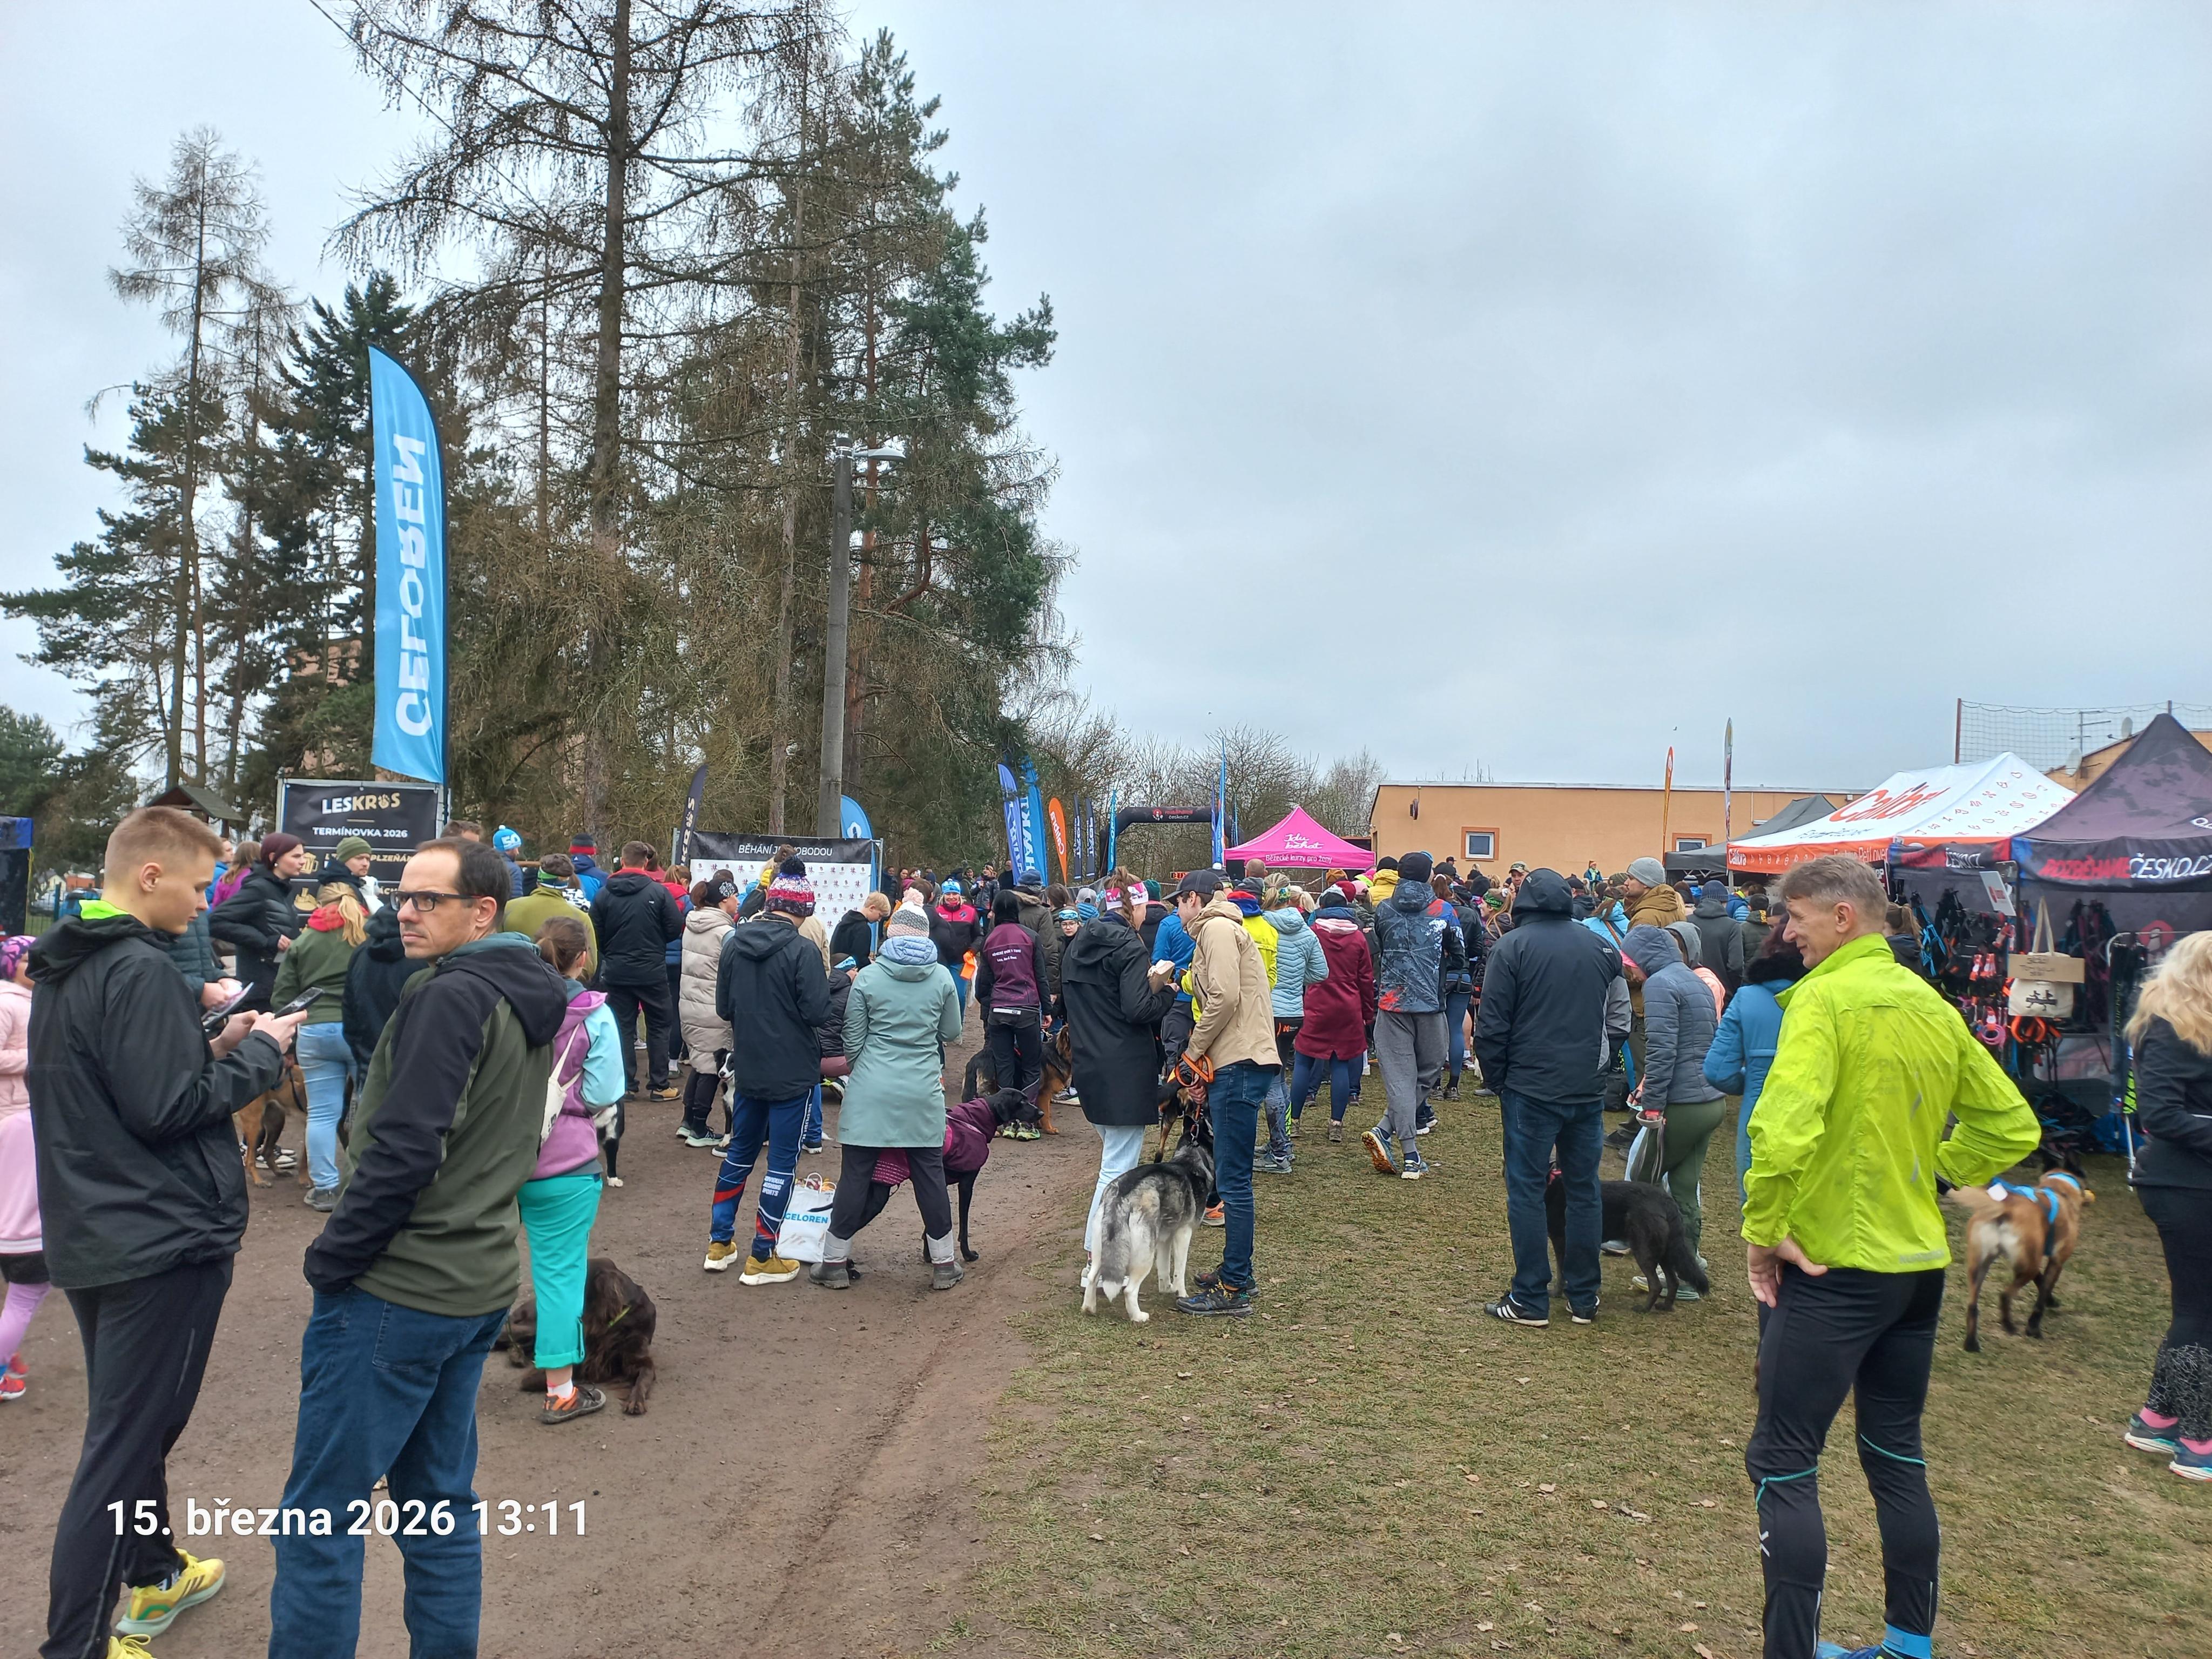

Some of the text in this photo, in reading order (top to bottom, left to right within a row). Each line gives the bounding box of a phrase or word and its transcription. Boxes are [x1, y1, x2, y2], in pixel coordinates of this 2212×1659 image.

[312, 825, 408, 838] TERMÍNOVKA 2026
[738, 843, 833, 856] BĚHÁNÍ J OBODOU
[1290, 855, 1305, 863] kurzy
[785, 1213, 828, 1224] GELOREN
